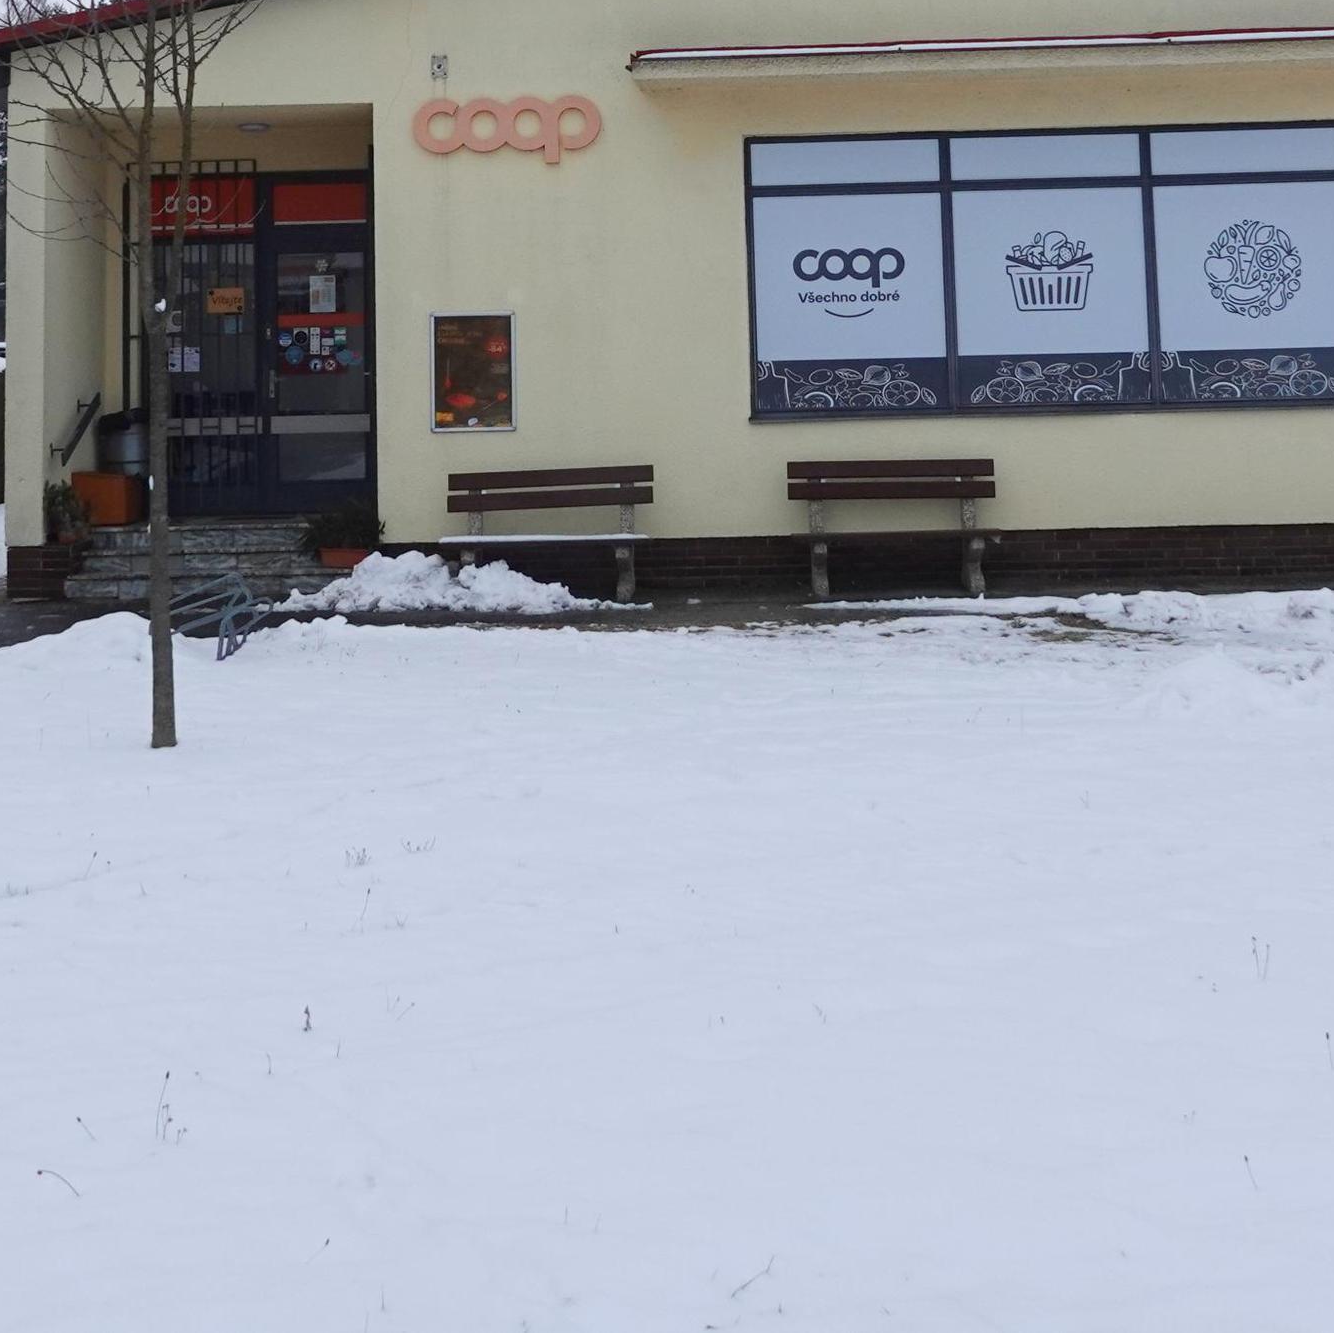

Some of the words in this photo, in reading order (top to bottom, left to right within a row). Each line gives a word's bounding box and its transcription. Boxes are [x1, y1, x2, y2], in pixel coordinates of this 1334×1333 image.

[412, 95, 602, 164] coop
[793, 247, 905, 288] coop
[798, 290, 857, 303] Všechno
[860, 290, 900, 302] dobré
